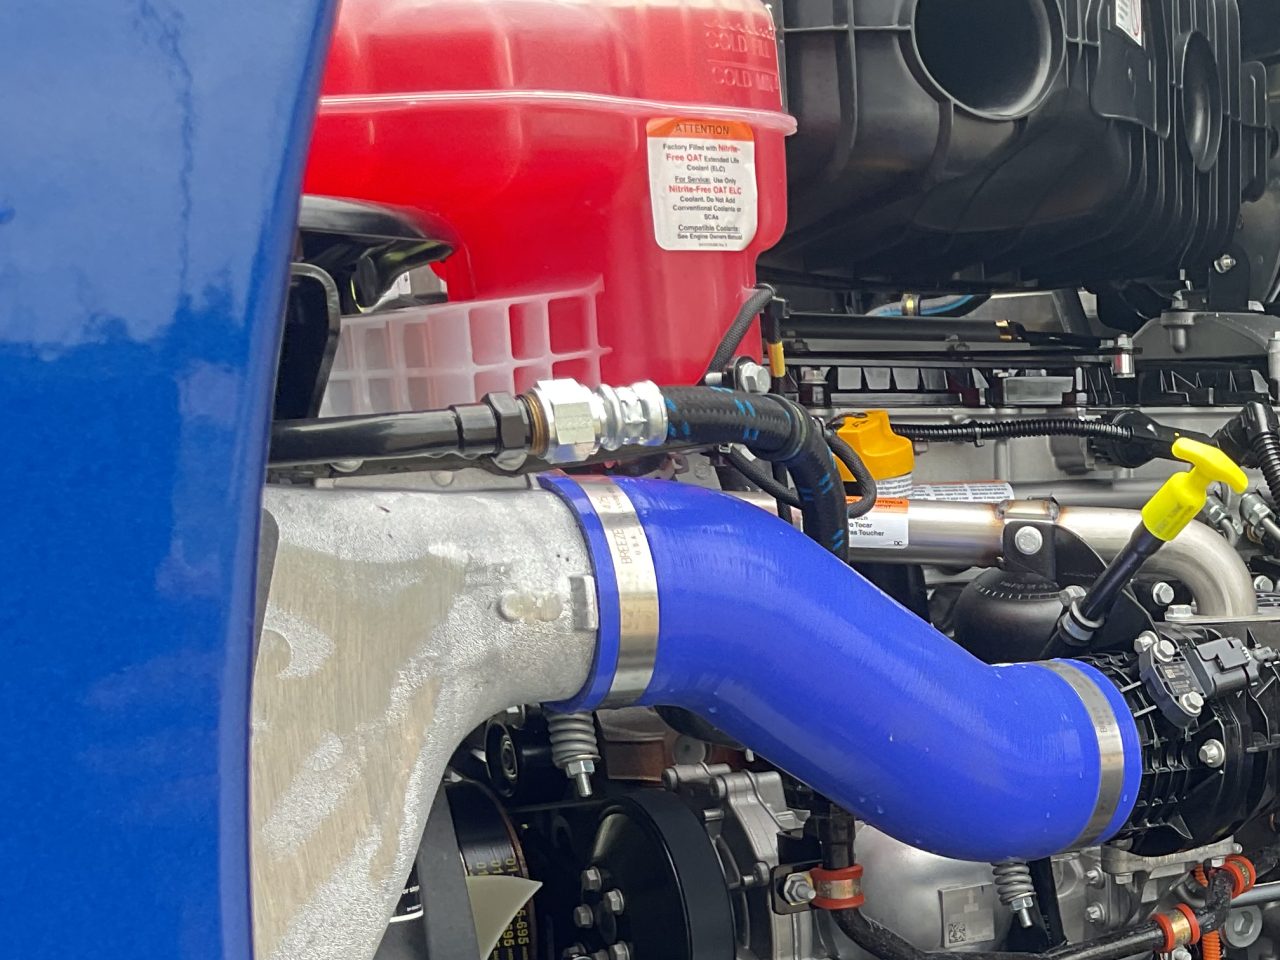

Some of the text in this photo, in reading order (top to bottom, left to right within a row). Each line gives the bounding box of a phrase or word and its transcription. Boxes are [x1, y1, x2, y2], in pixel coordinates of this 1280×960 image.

[676, 123, 729, 134] ATTENTION
[669, 185, 711, 193] Nitrite-Free
[713, 186, 726, 194] OAT
